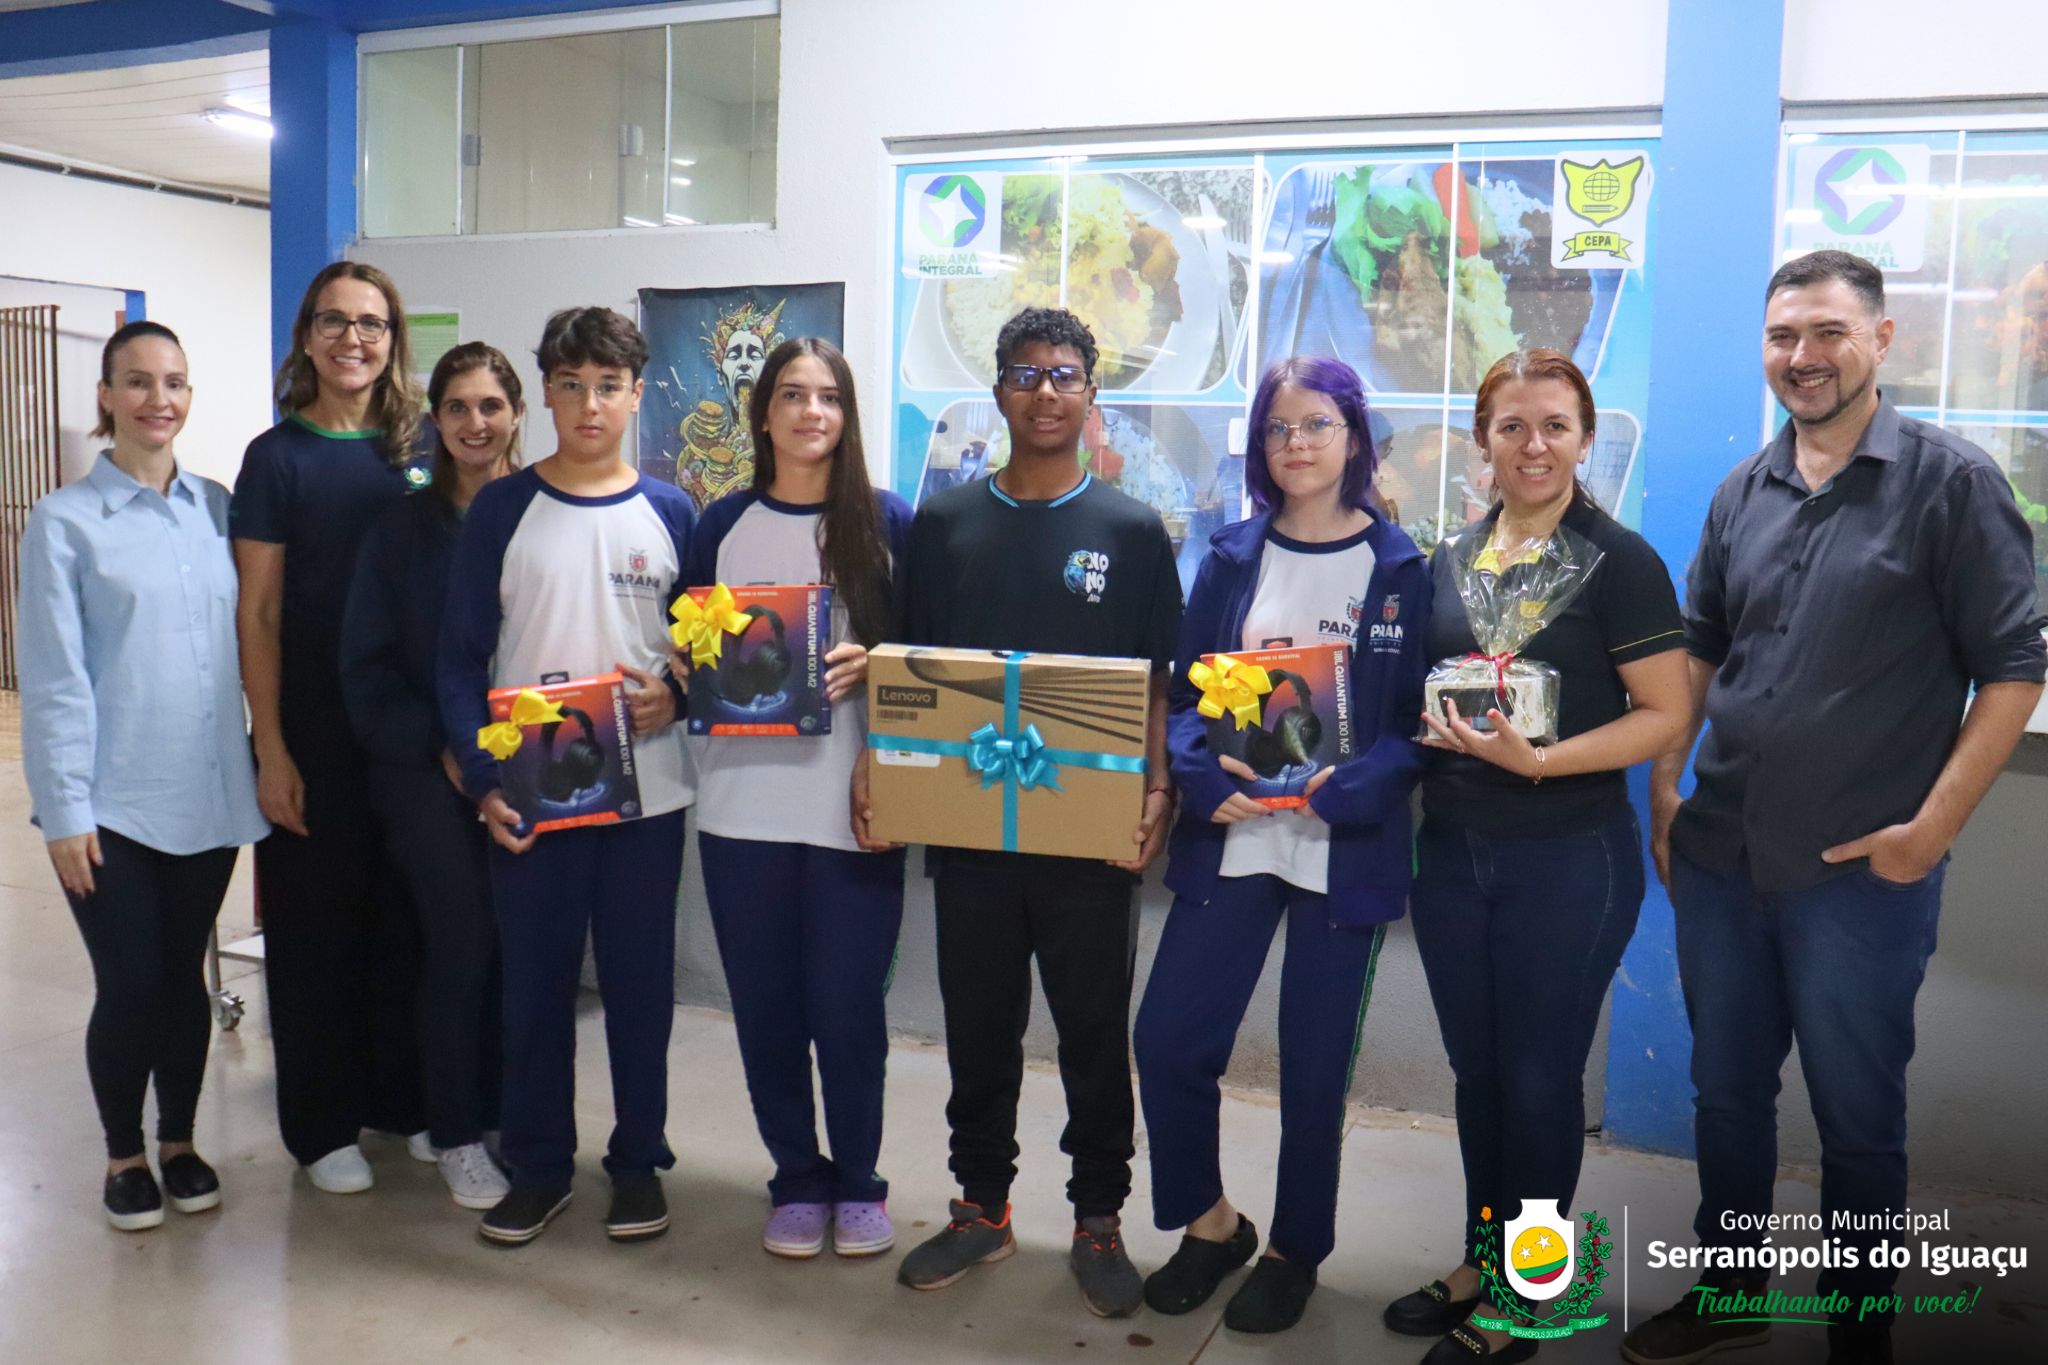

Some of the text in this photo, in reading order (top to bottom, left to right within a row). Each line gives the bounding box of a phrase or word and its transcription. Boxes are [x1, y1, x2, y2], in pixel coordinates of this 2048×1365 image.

[1584, 235, 1611, 246] CEPA
[1085, 570, 1105, 594] NO
[807, 604, 817, 655] QUANTUM
[808, 657, 817, 671] 100
[807, 672, 817, 688] M2
[882, 688, 931, 703] Lenovo
[1335, 665, 1348, 720] QUANTUM
[612, 699, 627, 747] QUANTUM
[1338, 720, 1348, 736] 100
[1340, 738, 1350, 754] M2
